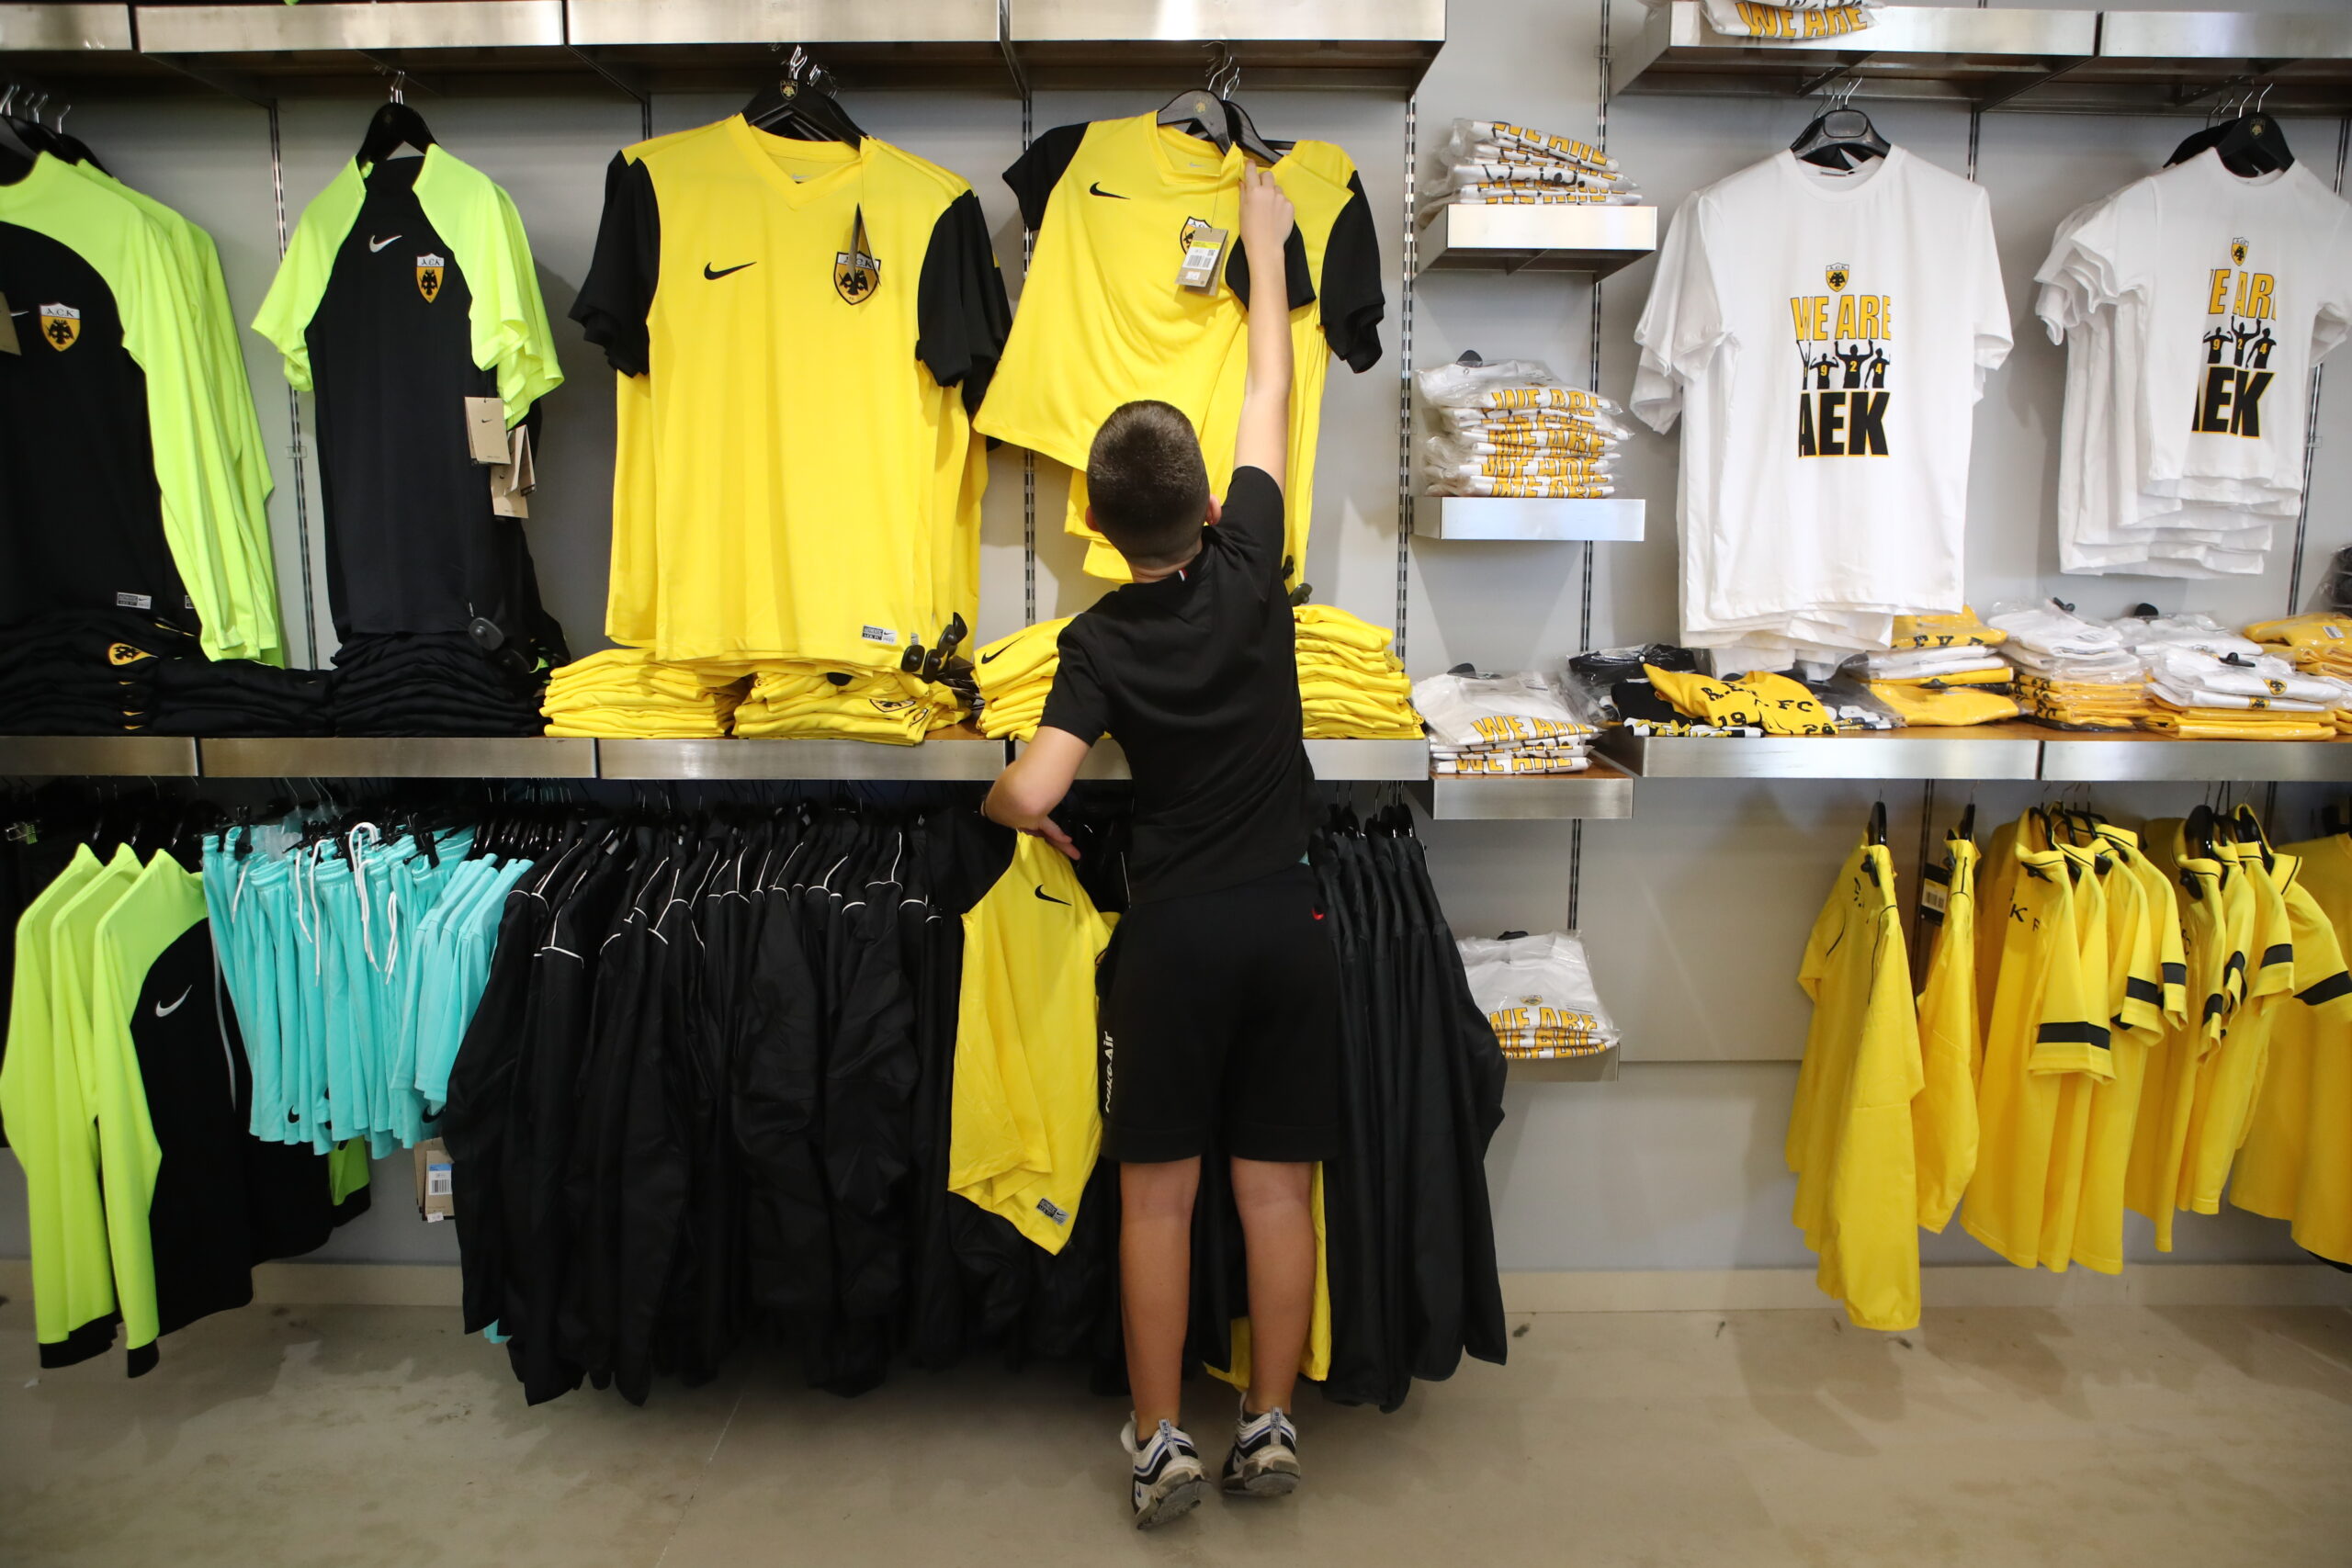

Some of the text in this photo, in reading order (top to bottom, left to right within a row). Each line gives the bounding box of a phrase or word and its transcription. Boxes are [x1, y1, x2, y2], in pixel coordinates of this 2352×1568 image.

[1736, 2, 1867, 38] WE ARE
[1790, 294, 1891, 341] WE ARE
[2212, 337, 2267, 355] 9 2 4
[1820, 365, 1828, 377] 9
[1849, 361, 1858, 372] 2
[1875, 363, 1883, 374] 4
[1798, 390, 1891, 457] AEK
[1778, 700, 1814, 712] FC
[1471, 716, 1529, 742] WE
[1717, 712, 1747, 727] 19
[1103, 1031, 1114, 1061] Air
